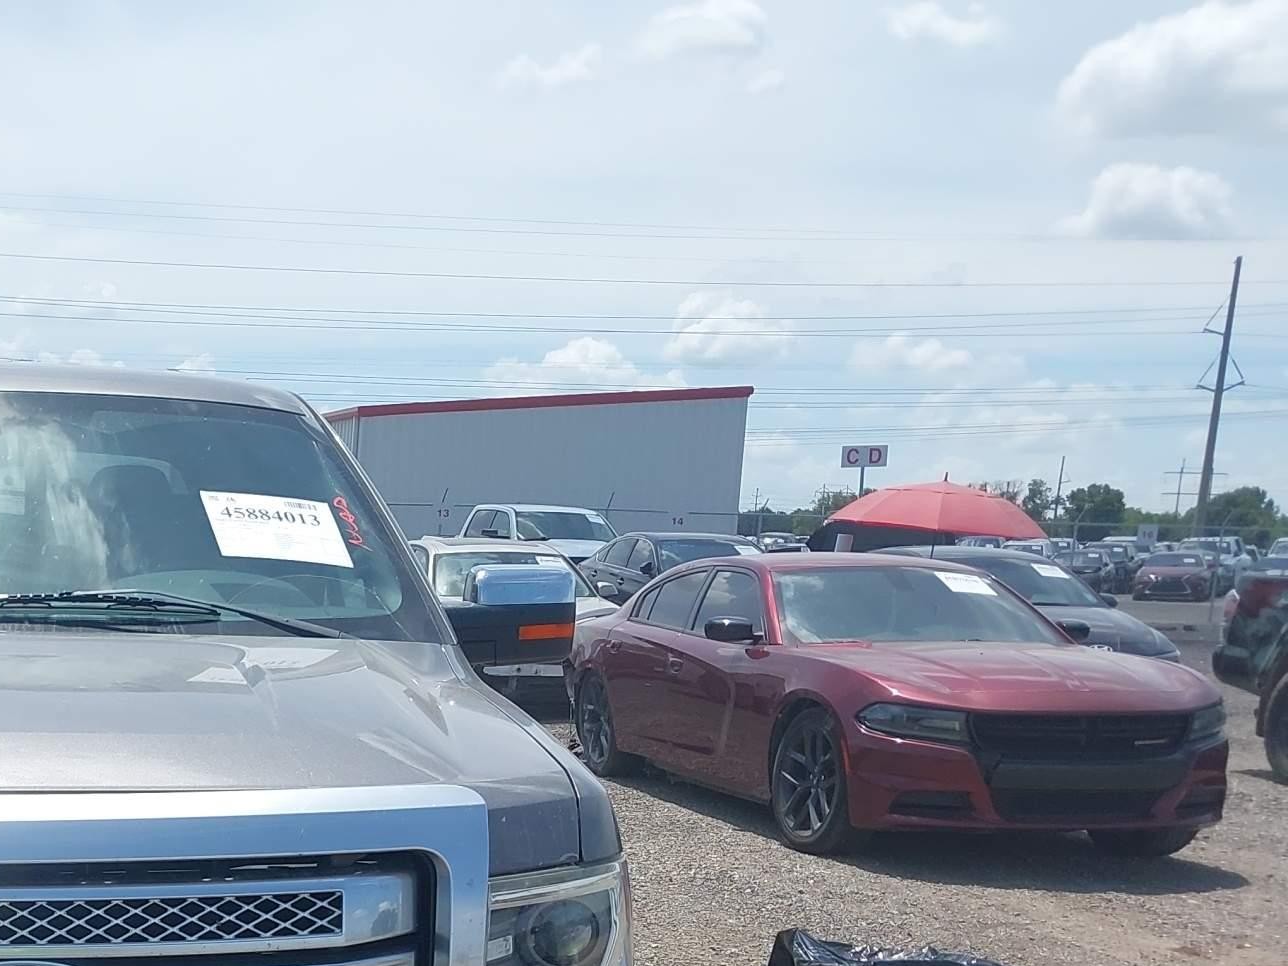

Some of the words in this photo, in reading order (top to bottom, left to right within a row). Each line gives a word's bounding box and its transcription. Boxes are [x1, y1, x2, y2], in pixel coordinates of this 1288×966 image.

[846, 447, 859, 465] C
[868, 447, 882, 464] D
[220, 505, 321, 528] 45884013
[437, 509, 450, 518] 13
[672, 517, 684, 525] 14
